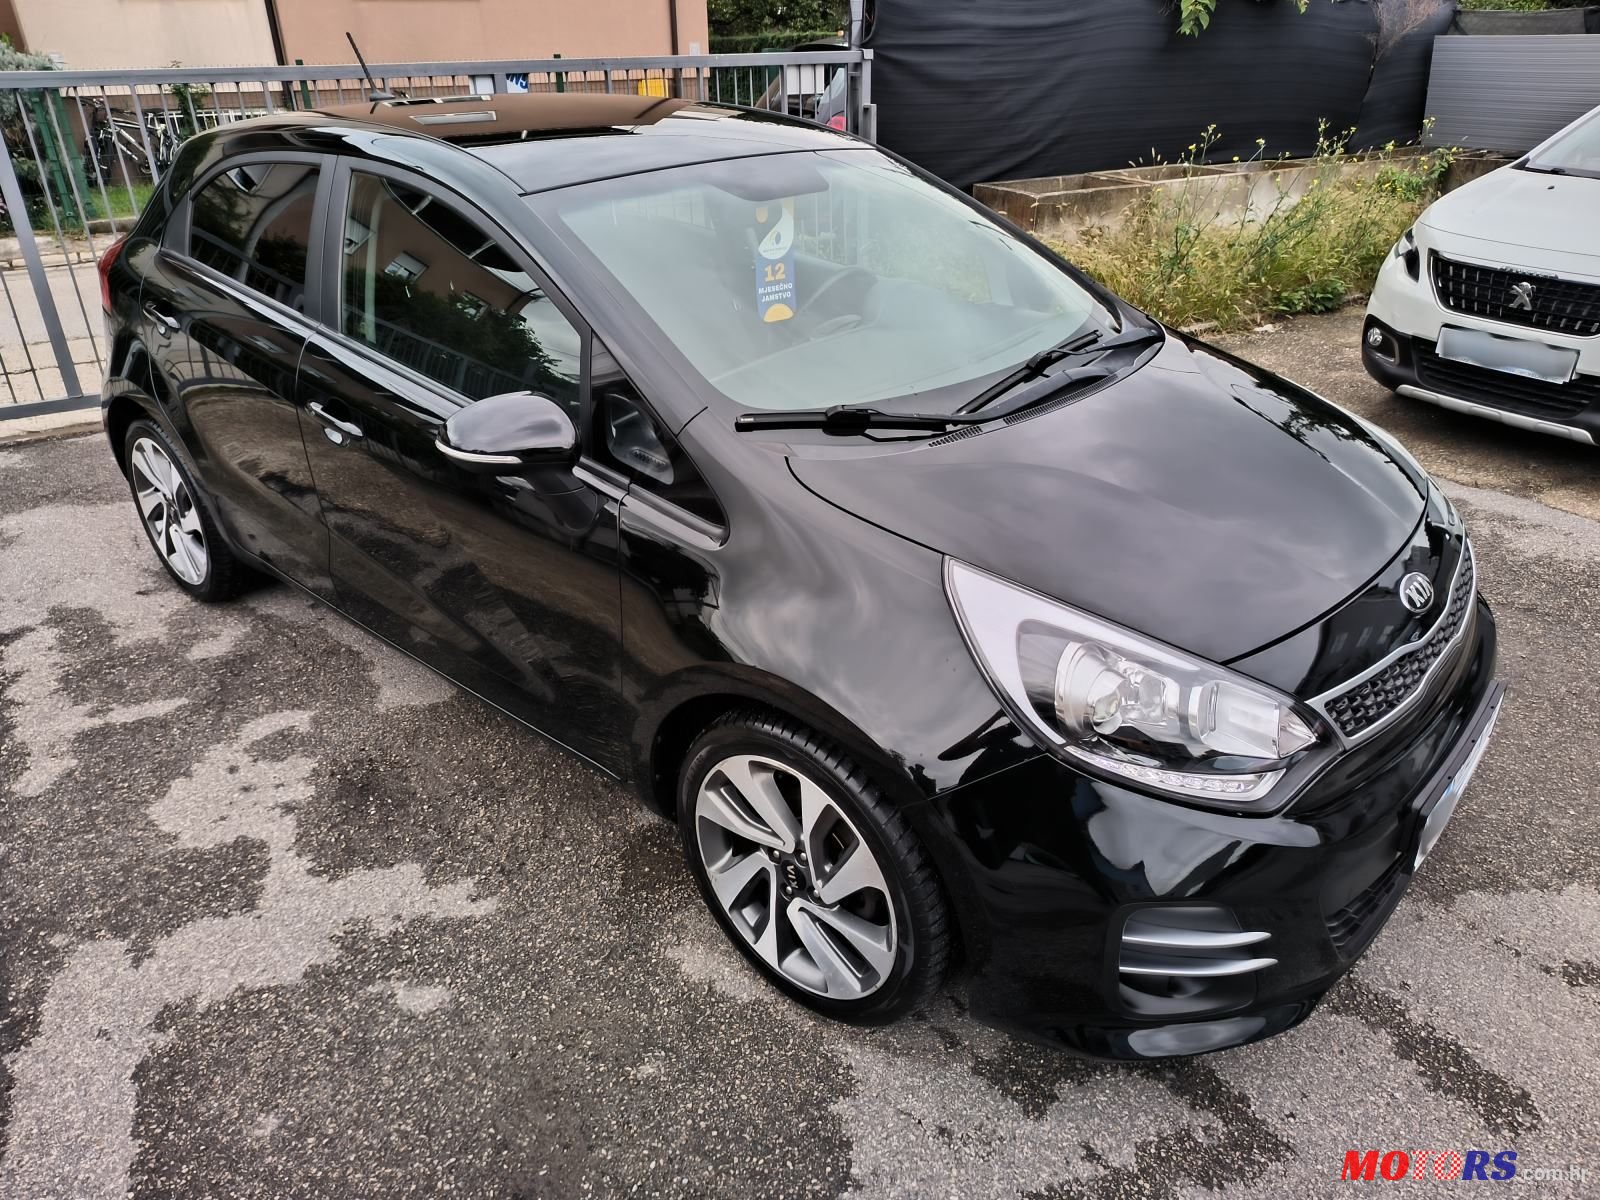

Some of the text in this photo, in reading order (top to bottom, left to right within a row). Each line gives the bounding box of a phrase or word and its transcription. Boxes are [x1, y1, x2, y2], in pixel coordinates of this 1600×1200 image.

[764, 262, 786, 282] 12
[758, 282, 793, 294] MJESEČNO
[761, 291, 792, 303] JAMSTVO
[786, 865, 799, 889] KIA
